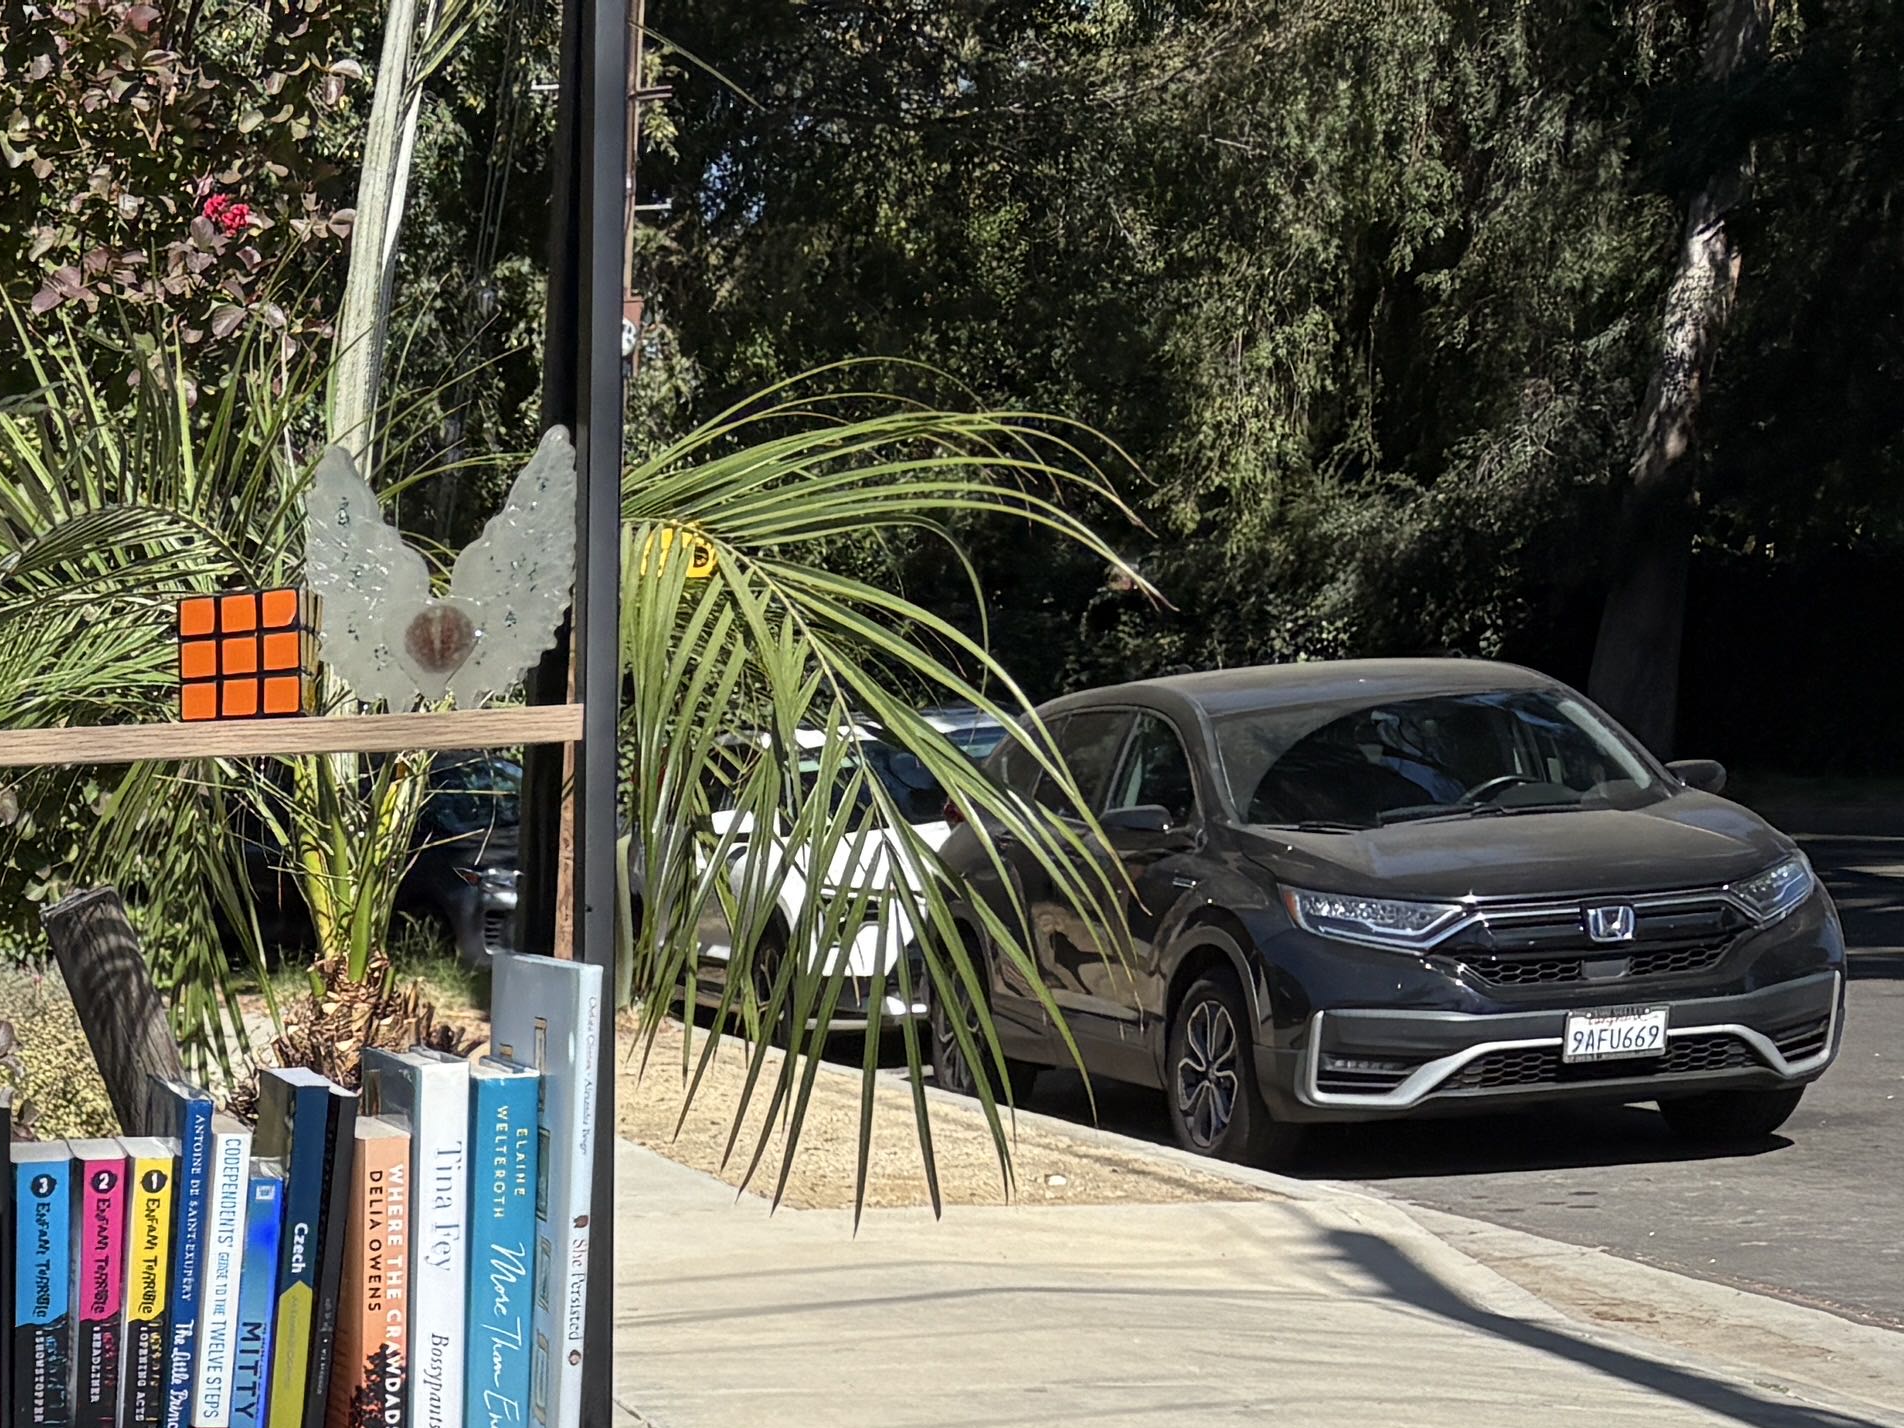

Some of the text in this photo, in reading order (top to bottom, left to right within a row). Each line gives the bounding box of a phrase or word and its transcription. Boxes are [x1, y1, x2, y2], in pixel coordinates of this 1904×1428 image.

[1573, 1025, 1659, 1053] 9AFU669
[190, 1114, 205, 1176] ANTOINE
[491, 1105, 509, 1218] WELTEROTH
[514, 1127, 529, 1196] ELAINE
[386, 1163, 406, 1247] WHERE
[424, 1140, 463, 1272] Tina Fey
[289, 1221, 310, 1275] Czech
[368, 1169, 383, 1313] DELIA OWENS
[385, 1254, 403, 1299] THE
[489, 1240, 527, 1316] More
[567, 1273, 587, 1341] Persisted
[170, 1346, 193, 1384] Little
[173, 1319, 195, 1346] The
[478, 1316, 523, 1387] Than
[202, 1318, 229, 1420] TWELVE STEPS
[233, 1320, 263, 1420] MITTY
